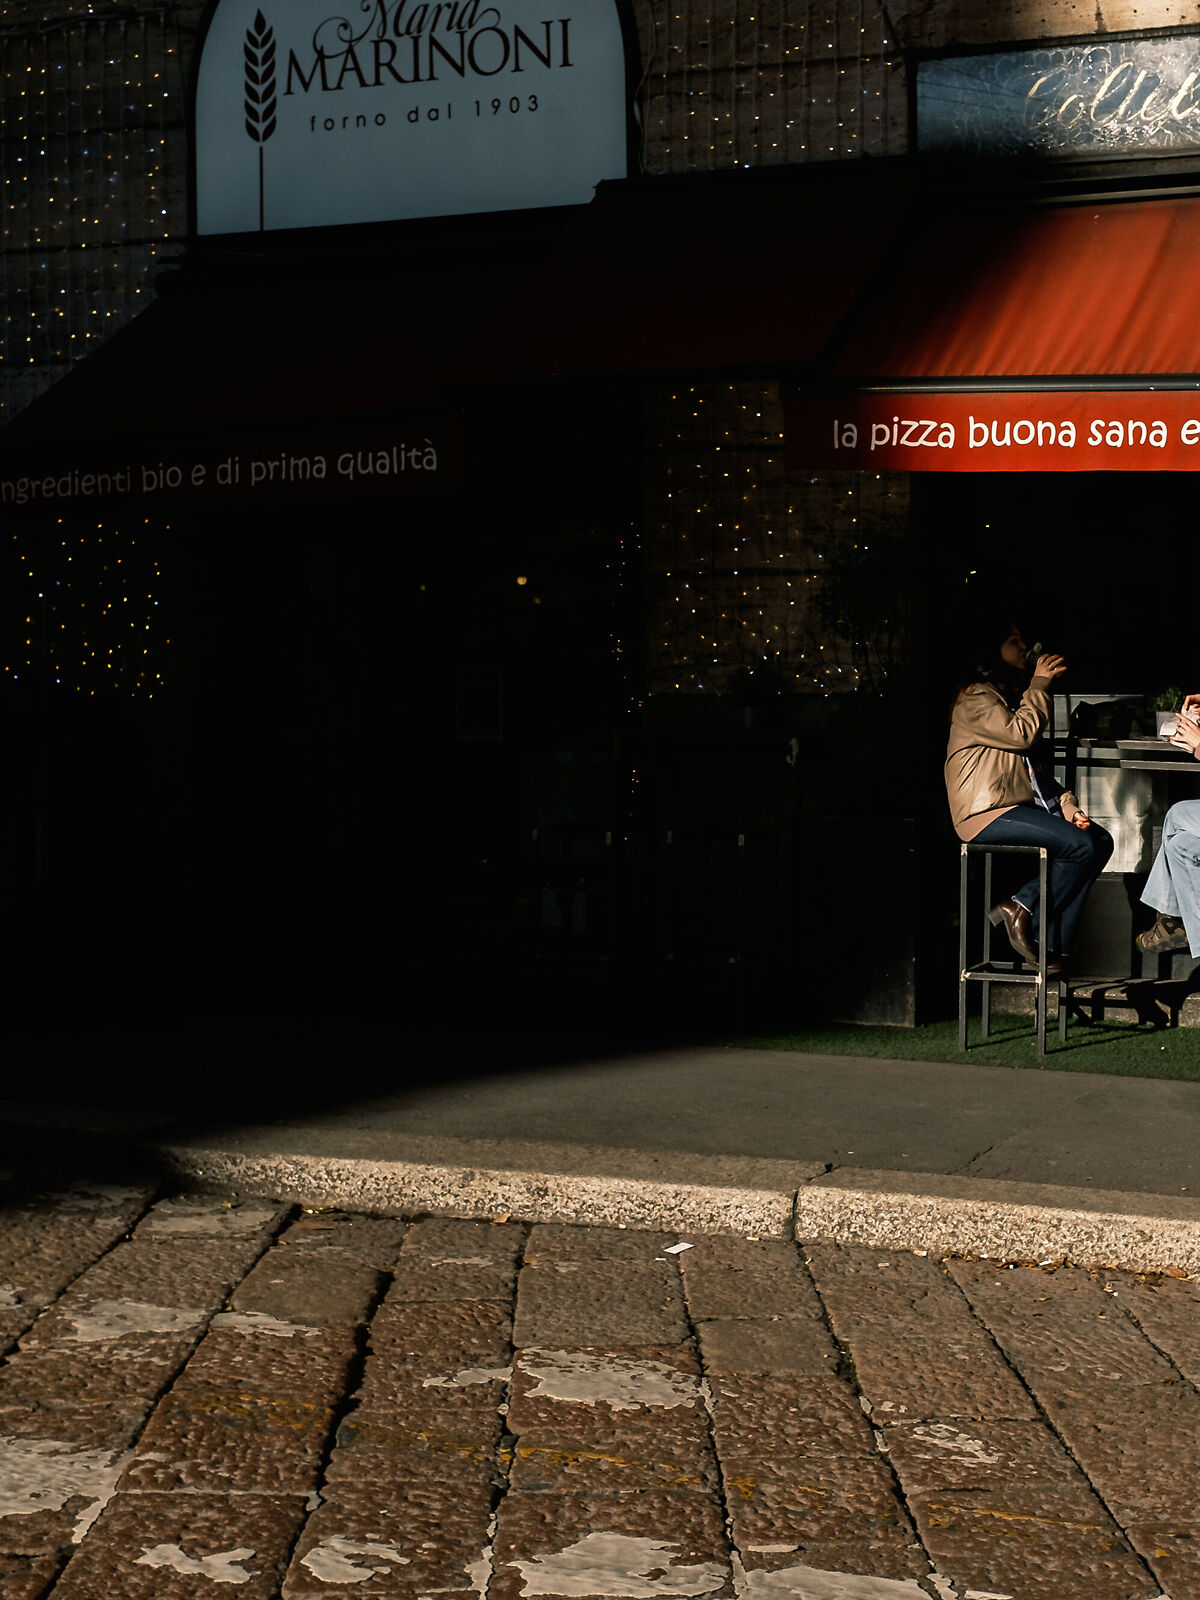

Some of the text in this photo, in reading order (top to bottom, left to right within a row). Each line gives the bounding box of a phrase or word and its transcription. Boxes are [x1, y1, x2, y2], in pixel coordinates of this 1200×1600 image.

[283, 18, 574, 96] MARINONI
[310, 95, 539, 132] forno dal 1903
[834, 419, 858, 448] la
[870, 416, 956, 450] pizza
[968, 416, 1077, 448] buona
[1087, 419, 1168, 448] sana
[0, 438, 437, 504] ngredienti bio e di prima qualità
